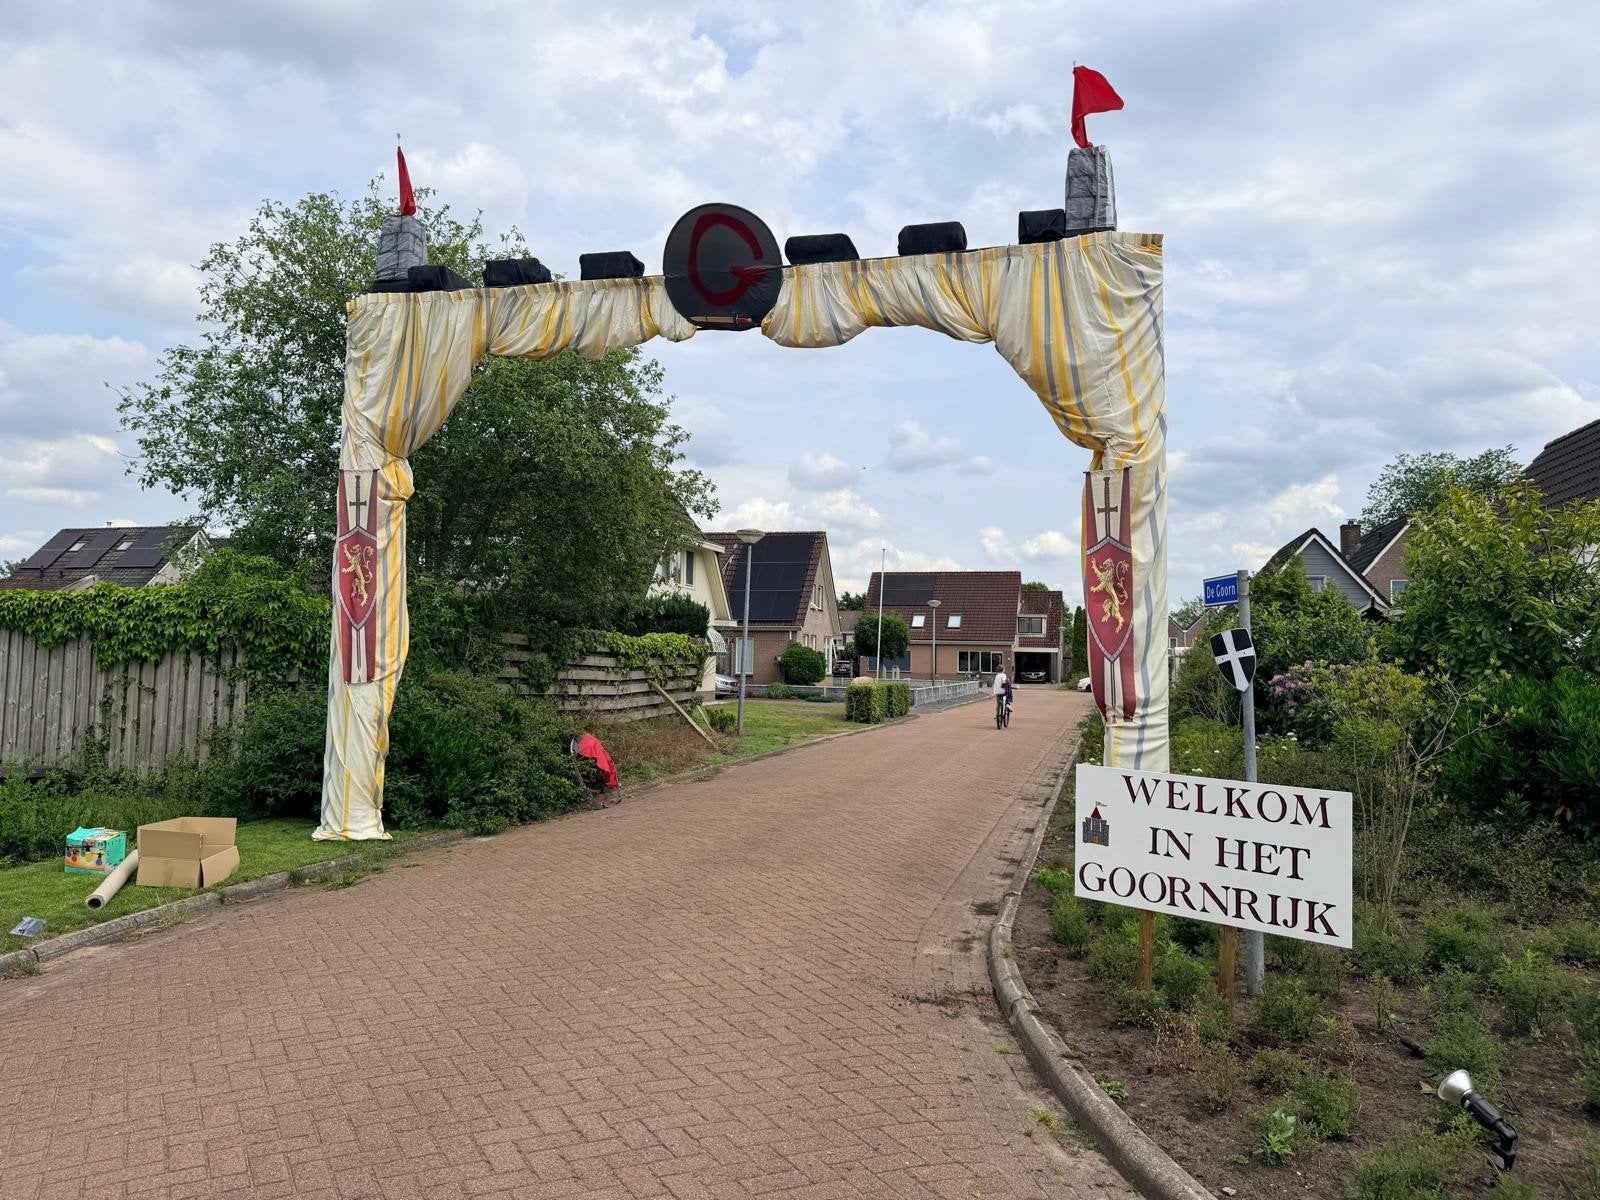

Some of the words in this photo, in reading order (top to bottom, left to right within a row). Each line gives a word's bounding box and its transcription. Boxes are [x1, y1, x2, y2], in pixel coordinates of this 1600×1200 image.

[688, 213, 768, 307] G
[1206, 586, 1215, 599] De
[1216, 584, 1236, 598] Goorn
[1121, 775, 1332, 829] WELKOM
[1149, 827, 1193, 861] IN
[1215, 836, 1311, 880] HET
[1079, 861, 1340, 938] GOORNRIJK
